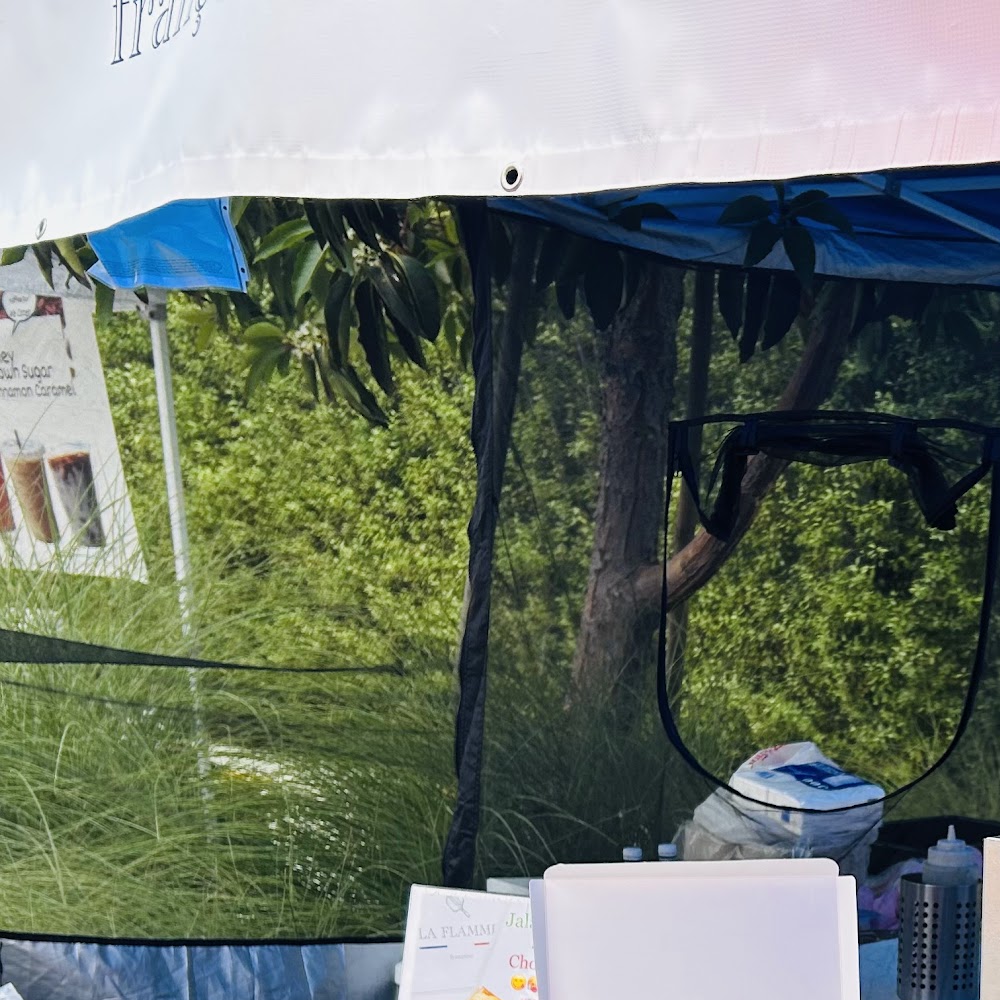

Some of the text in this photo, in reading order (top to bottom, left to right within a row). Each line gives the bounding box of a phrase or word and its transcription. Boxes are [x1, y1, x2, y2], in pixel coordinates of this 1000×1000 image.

[21, 364, 53, 384] Sugar
[35, 384, 76, 397] Caramel
[418, 927, 438, 940] LA
